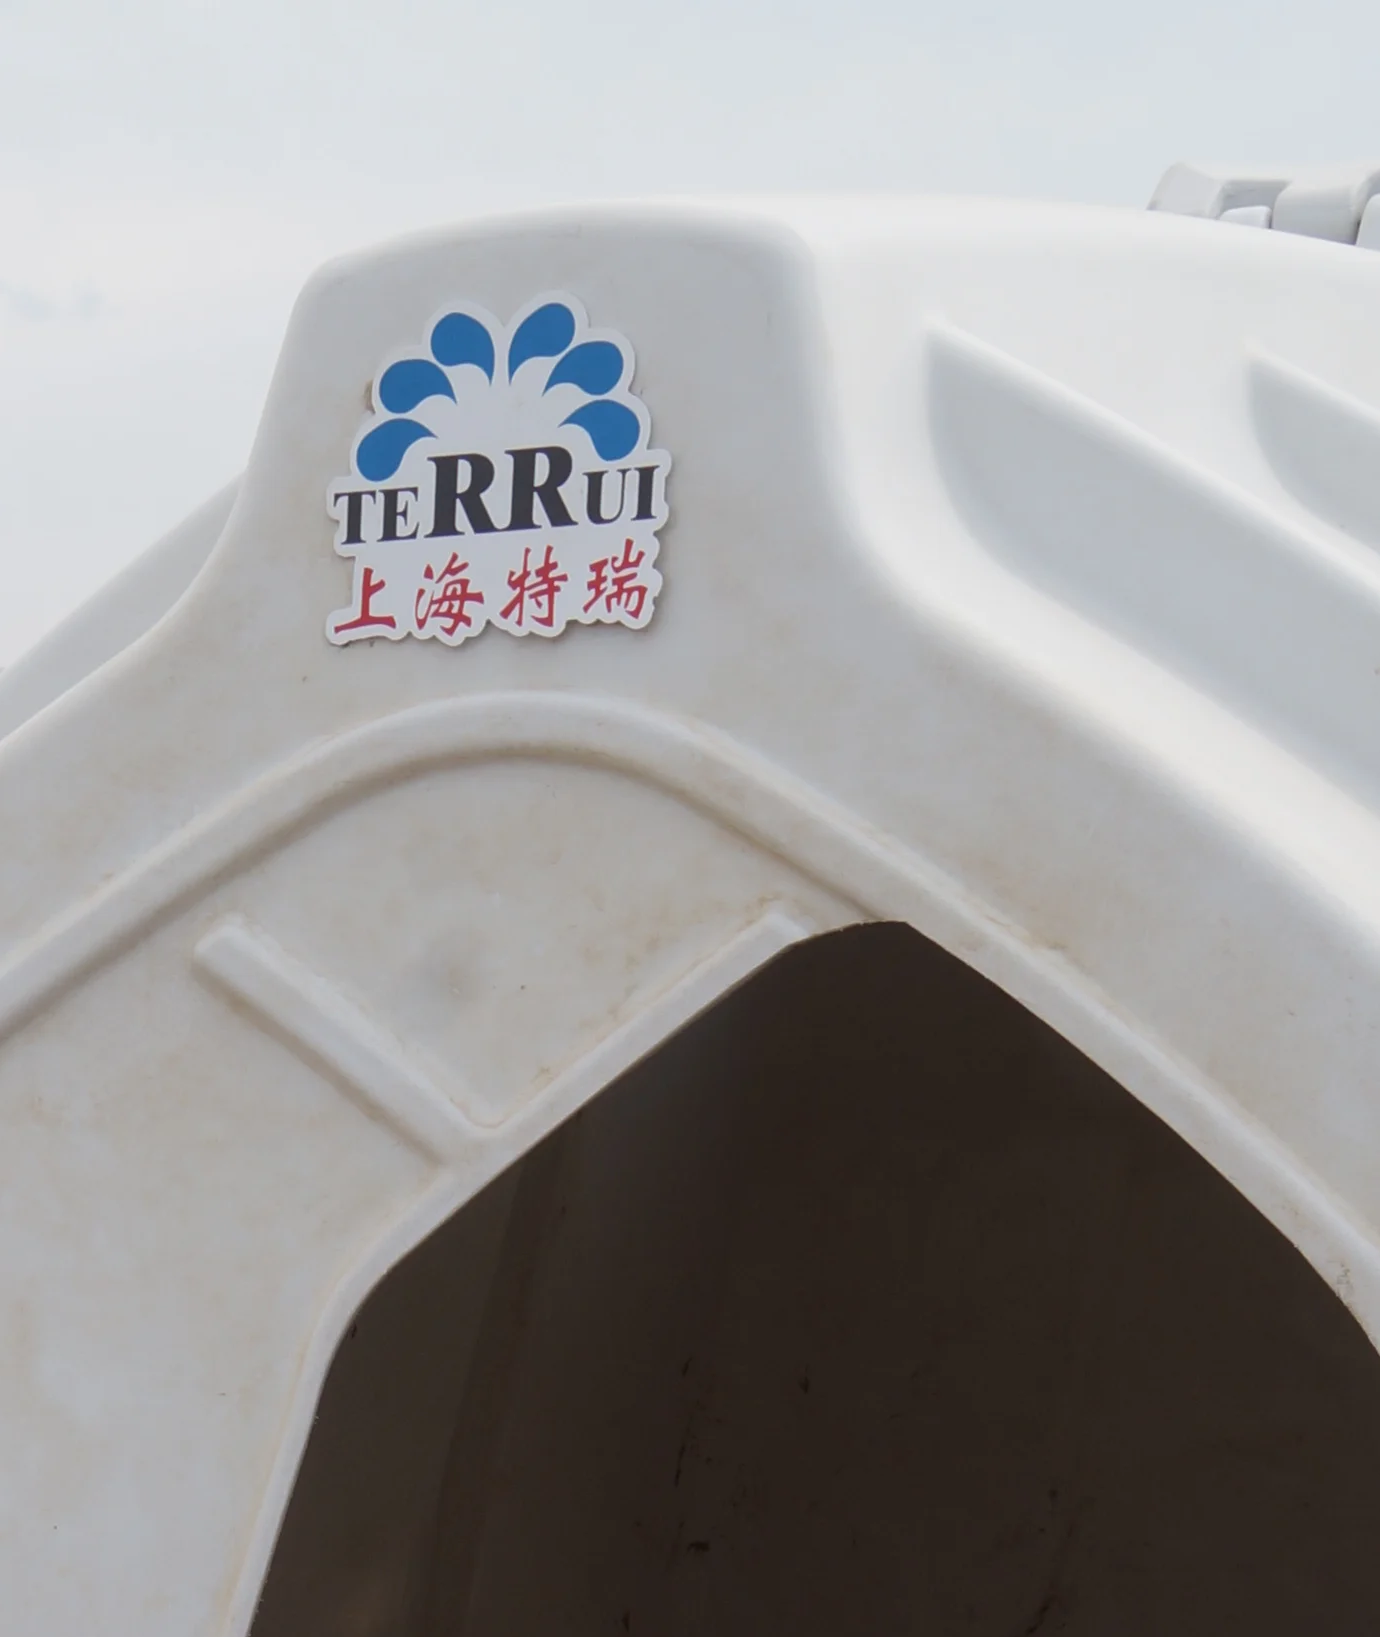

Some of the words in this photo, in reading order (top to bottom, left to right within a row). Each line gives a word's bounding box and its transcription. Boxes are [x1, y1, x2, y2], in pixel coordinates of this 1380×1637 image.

[333, 445, 660, 545] TERRUI
[333, 538, 649, 637] 上海特瑞
